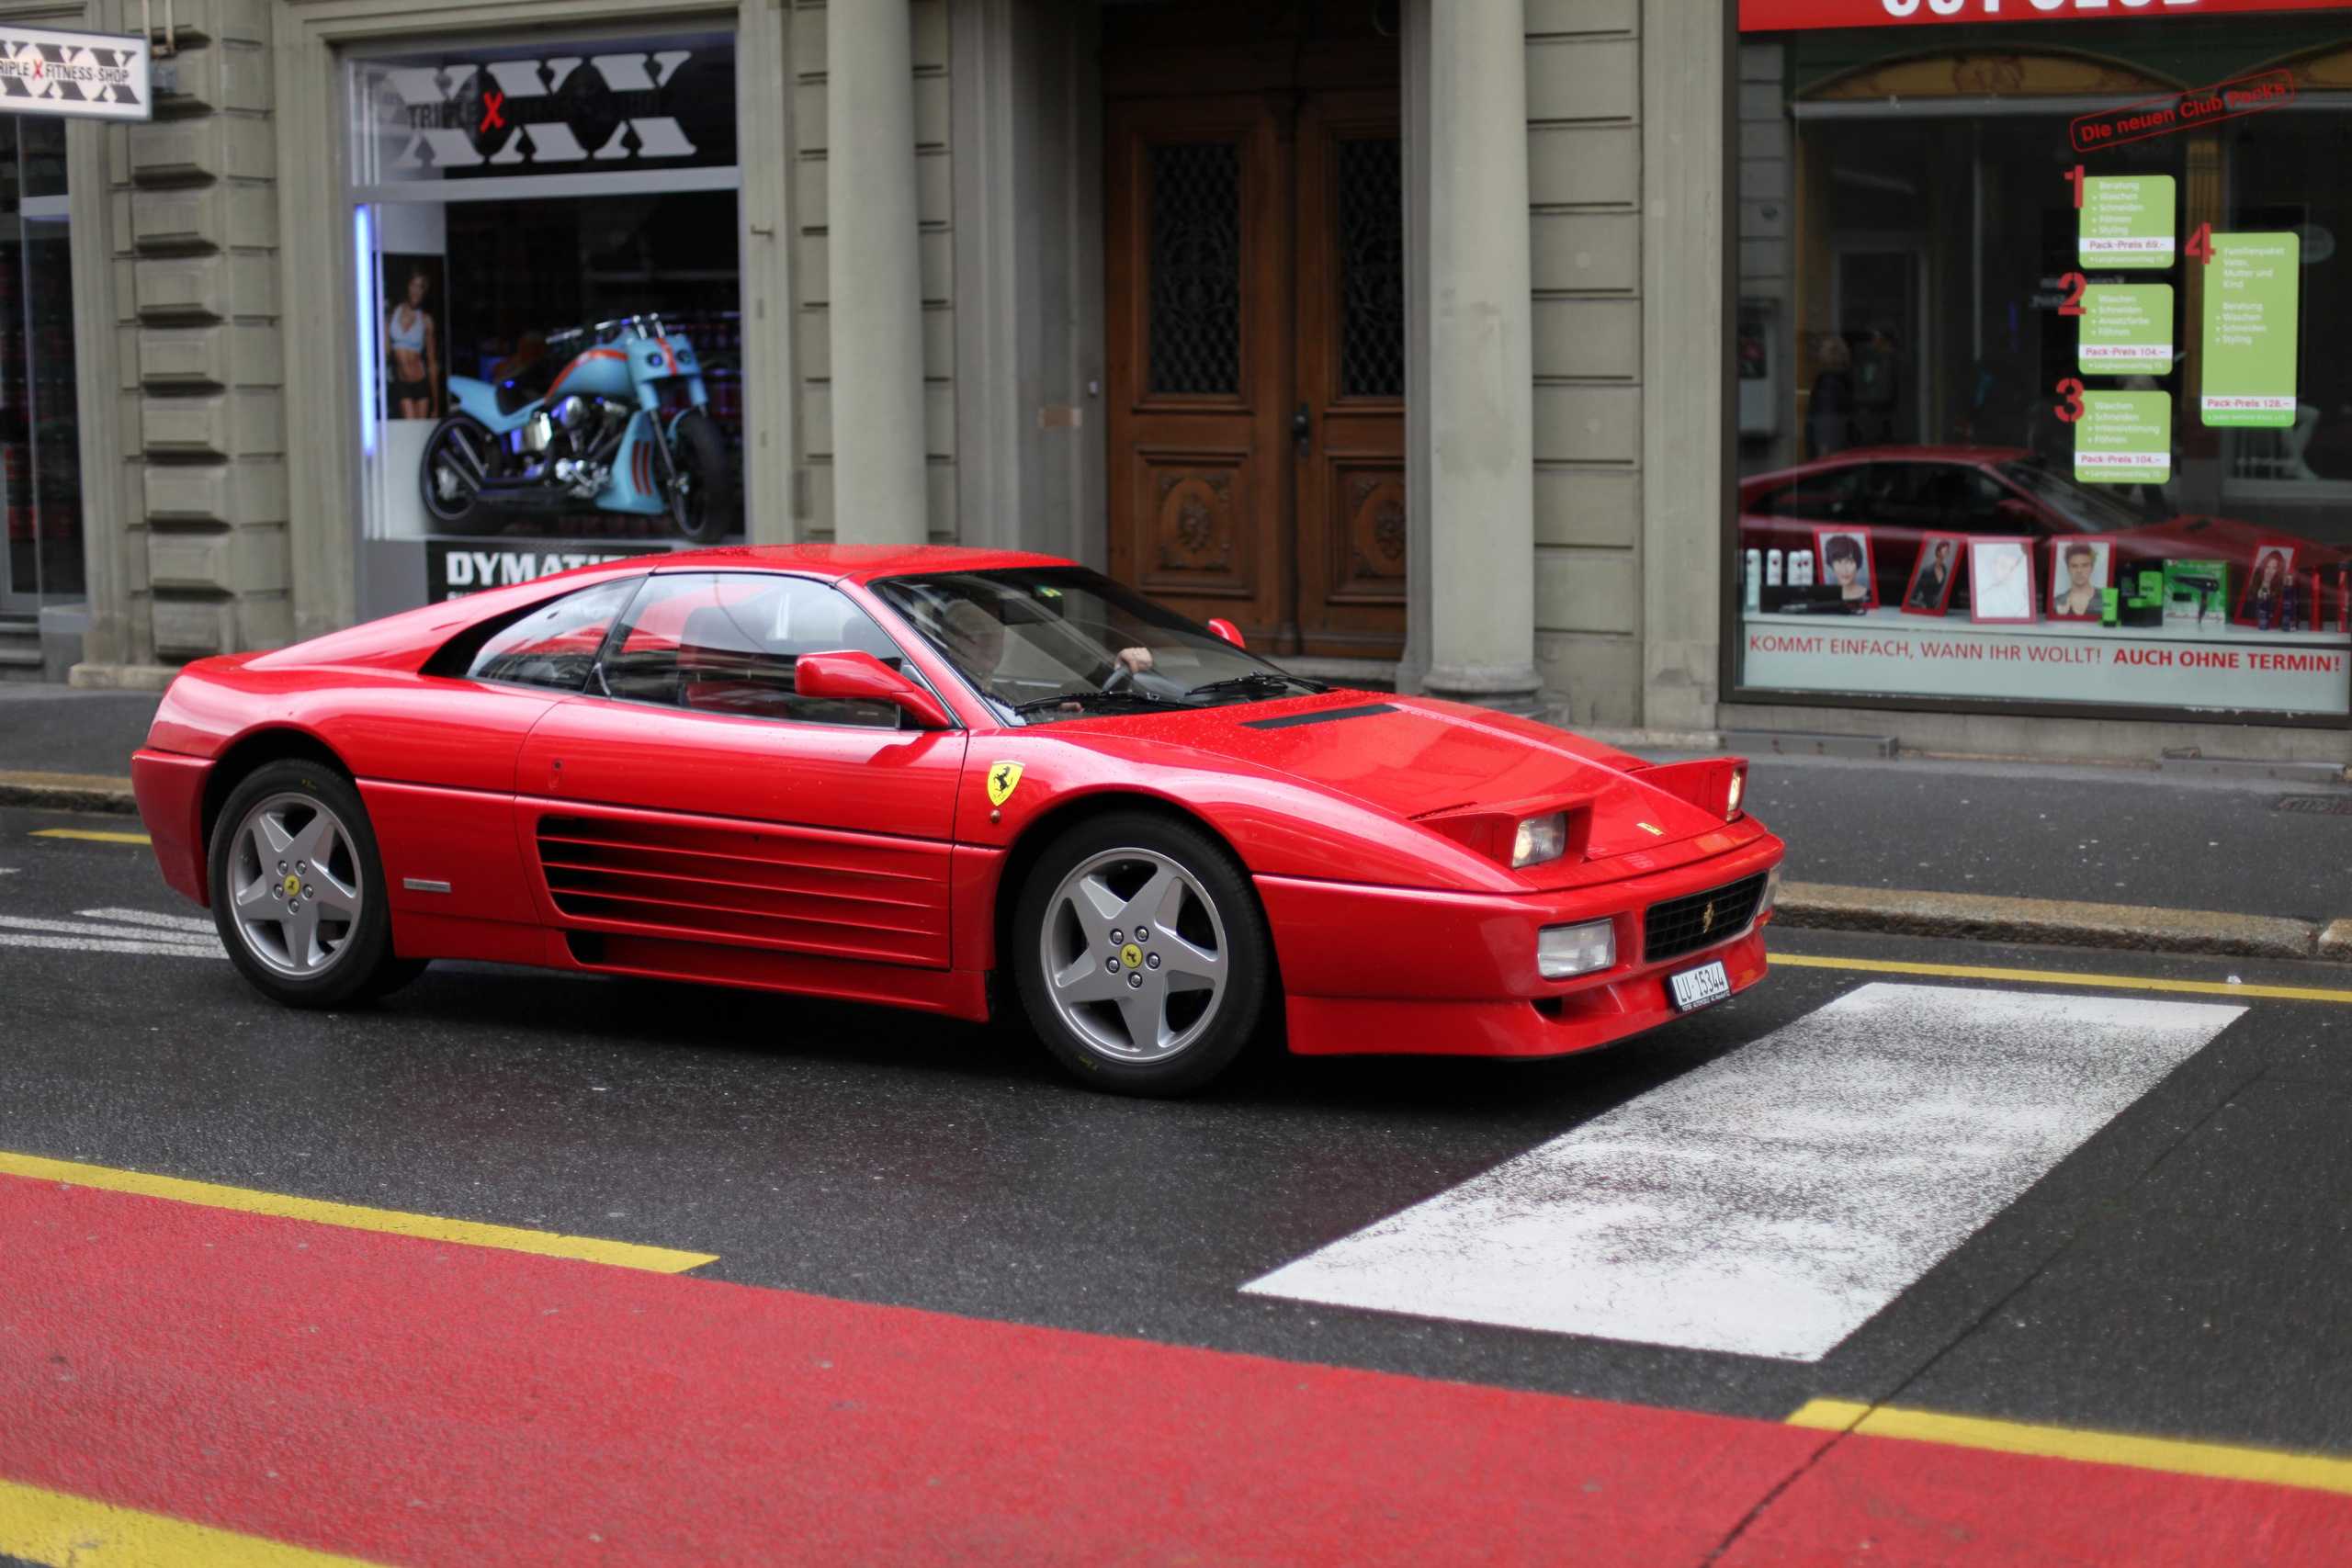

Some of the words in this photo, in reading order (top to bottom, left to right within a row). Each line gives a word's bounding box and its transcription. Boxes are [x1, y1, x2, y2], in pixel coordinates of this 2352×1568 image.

[32, 59, 44, 81] X
[2081, 123, 2112, 141] Die
[2117, 108, 2176, 134] neuen
[2180, 96, 2223, 118] Club
[2227, 83, 2286, 107] Packs
[2064, 164, 2085, 209] 1
[2099, 182, 2140, 191] Beratung
[2099, 226, 2129, 235] Styling
[2089, 240, 2143, 249] Pack-Preis
[2184, 222, 2216, 265] 4
[2223, 247, 2284, 256] Familienpaket
[2223, 269, 2254, 277] Mutter
[2256, 269, 2274, 277] und
[2223, 280, 2245, 288] Kind
[2058, 272, 2086, 315] 2
[2098, 295, 2137, 303] Waschen
[2098, 306, 2143, 314] Schneiden
[2222, 302, 2263, 311] Beratung
[2222, 313, 2261, 321] Waschen
[2222, 324, 2267, 333] Schneiden
[2222, 335, 2252, 344] Styling
[2086, 348, 2136, 356] Pack-Preis
[2054, 378, 2085, 423] 3
[2207, 399, 2260, 408] Pack-Preis
[2095, 401, 2133, 411] Waschen
[2095, 413, 2140, 422] Schneiden
[2081, 455, 2132, 464] Pack-Preis
[447, 551, 628, 586] DYMAT
[1749, 636, 1824, 653] KOMMT
[1830, 638, 1914, 660] EINFACH,
[1920, 642, 1982, 660] WANN
[1990, 645, 2021, 660] IHR
[2027, 645, 2101, 664] WOLLT!
[2113, 648, 2172, 666] AUCH
[2179, 650, 2240, 669] OHNE
[2247, 653, 2340, 671] TERMIN!
[1676, 976, 1692, 1003] LU
[1694, 965, 1724, 996] 15344
